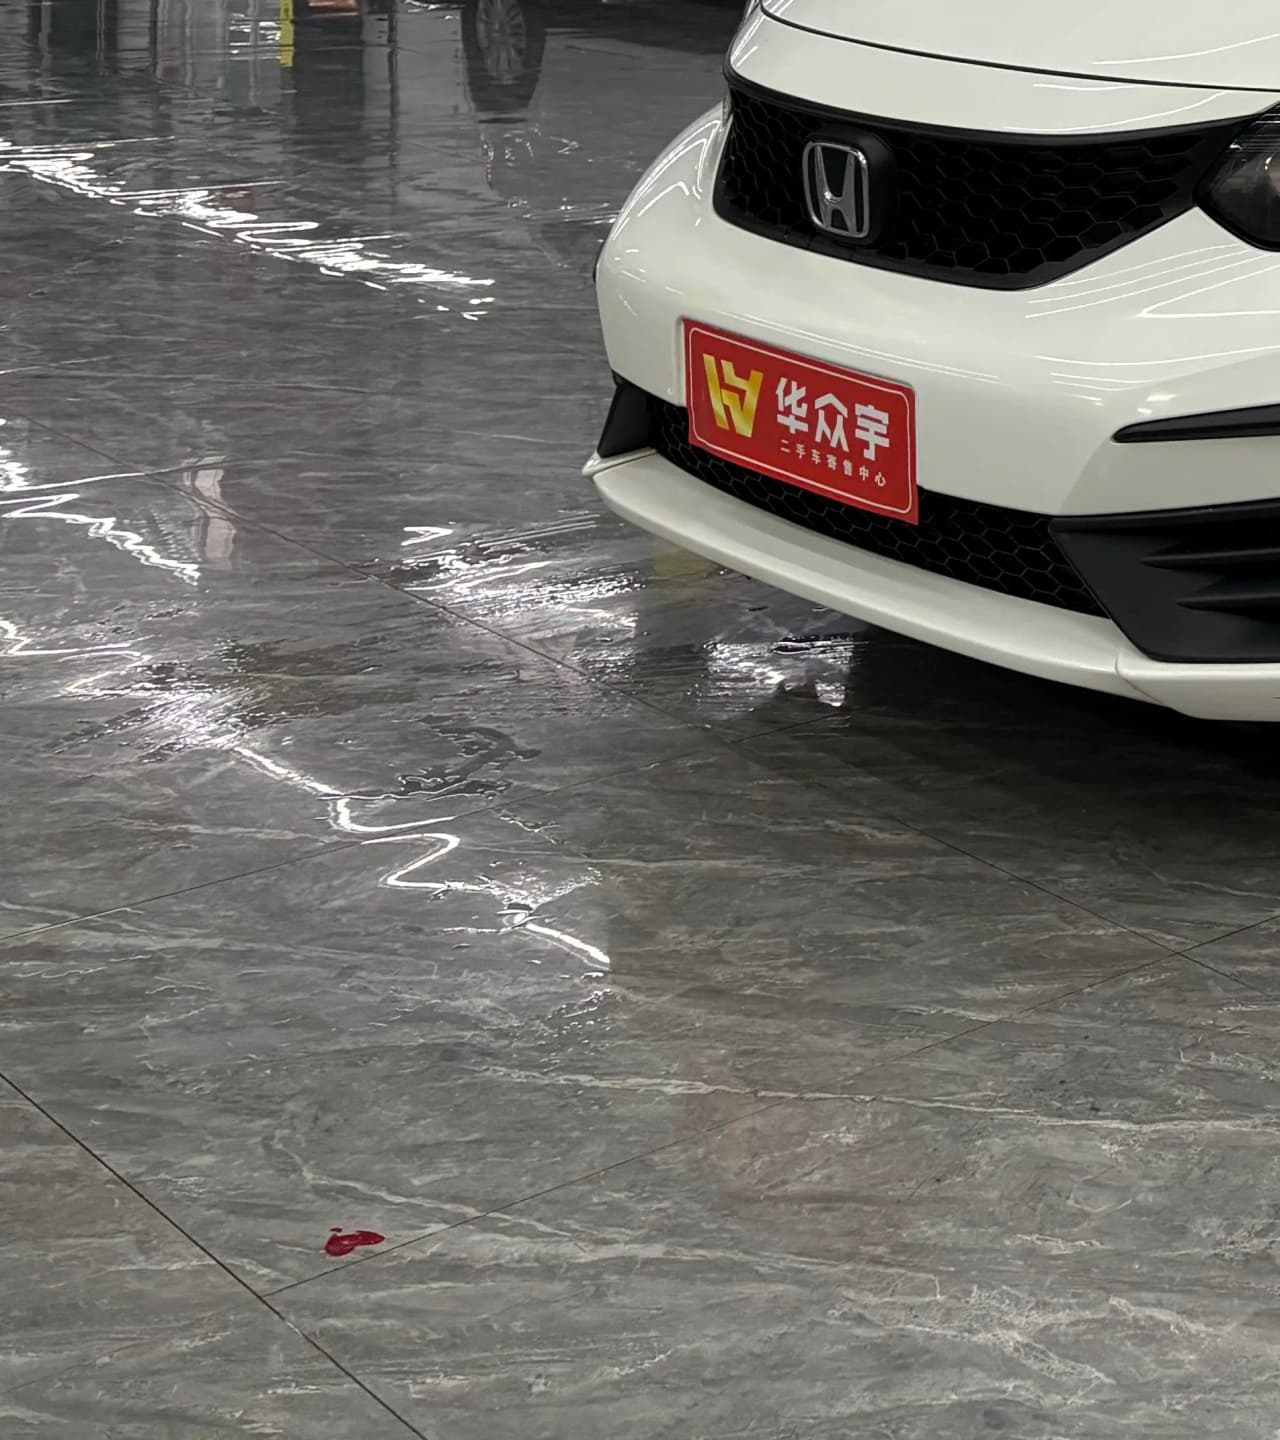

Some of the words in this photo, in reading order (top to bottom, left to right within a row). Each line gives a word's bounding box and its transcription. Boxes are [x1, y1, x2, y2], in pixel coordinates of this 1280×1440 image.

[775, 377, 890, 461] 华众宇
[780, 439, 887, 487] 二手车寄售中心
